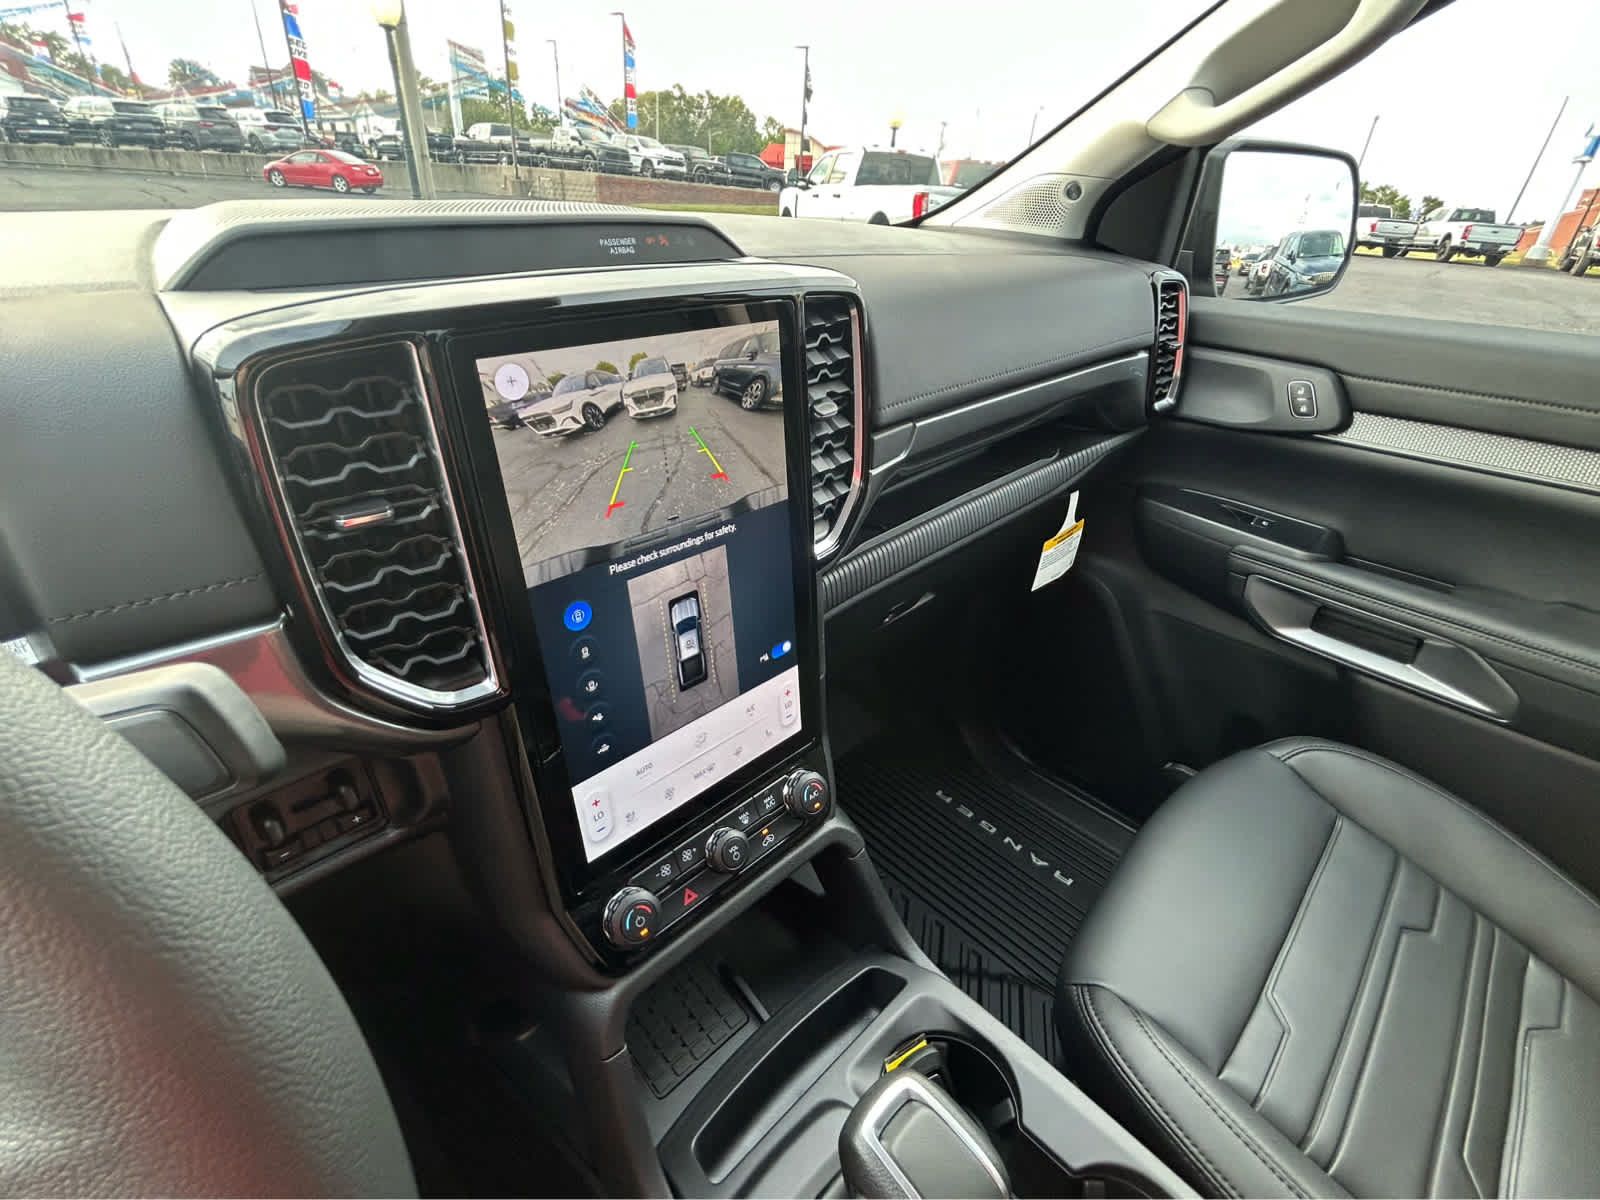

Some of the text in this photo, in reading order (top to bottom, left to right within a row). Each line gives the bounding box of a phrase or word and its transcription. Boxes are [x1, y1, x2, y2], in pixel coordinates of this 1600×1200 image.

[600, 237, 636, 248] PASSENGER
[610, 245, 635, 255] AIRBAG
[609, 523, 737, 575] Please check surroundings for safety.
[635, 762, 654, 776] AUTO
[765, 799, 776, 810] A/C
[592, 810, 605, 823] LO
[935, 789, 1074, 886] RANGER
